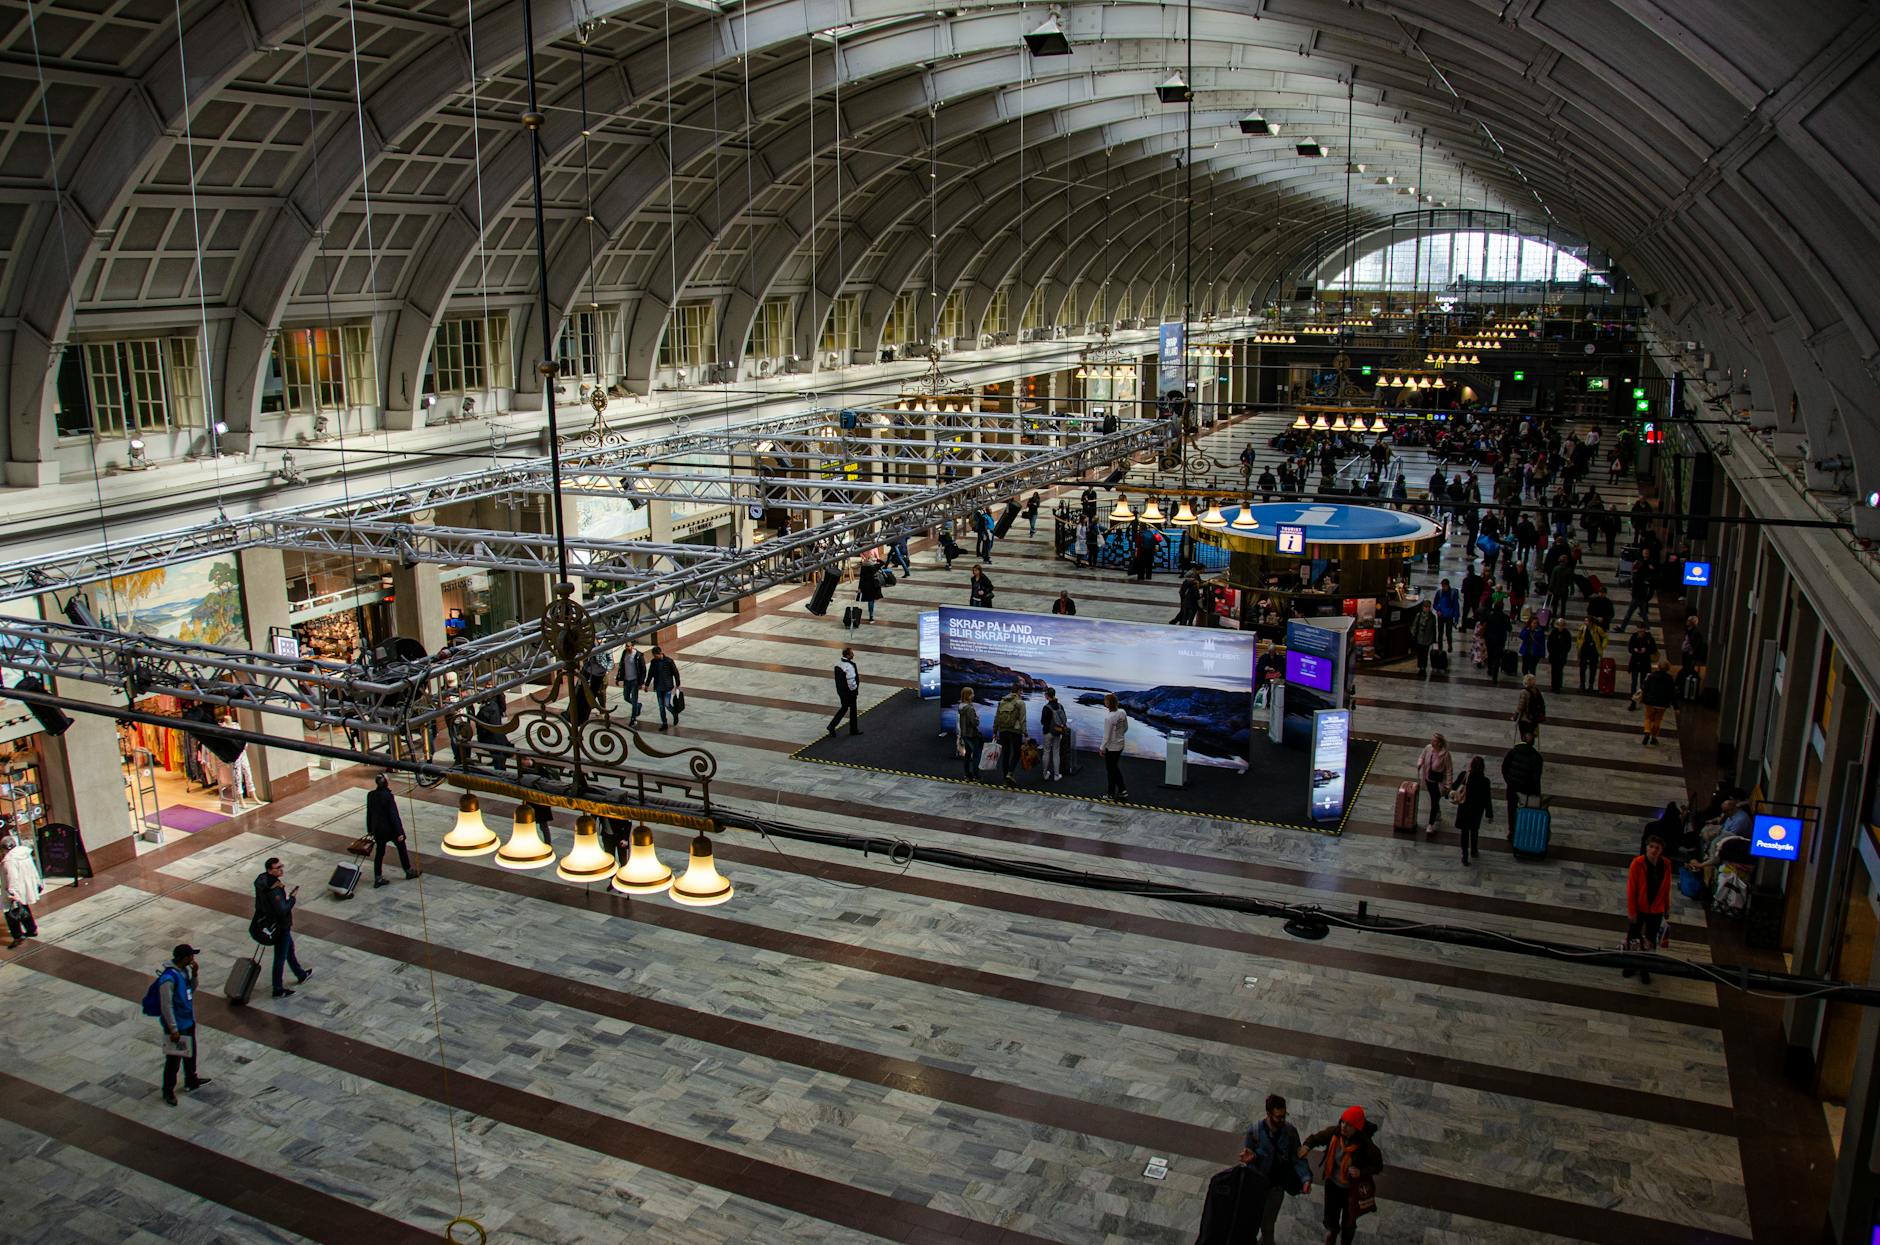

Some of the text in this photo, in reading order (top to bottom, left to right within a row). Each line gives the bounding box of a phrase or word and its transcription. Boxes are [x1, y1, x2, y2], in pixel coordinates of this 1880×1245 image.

[1435, 295, 1458, 304] Lounge
[949, 617, 985, 630] SKRÄP
[987, 620, 1001, 632] PÅ
[1003, 623, 1033, 635] LAND
[949, 627, 973, 640] BLIR
[975, 629, 1011, 642] SKRÄP
[1017, 634, 1054, 647] HAVET
